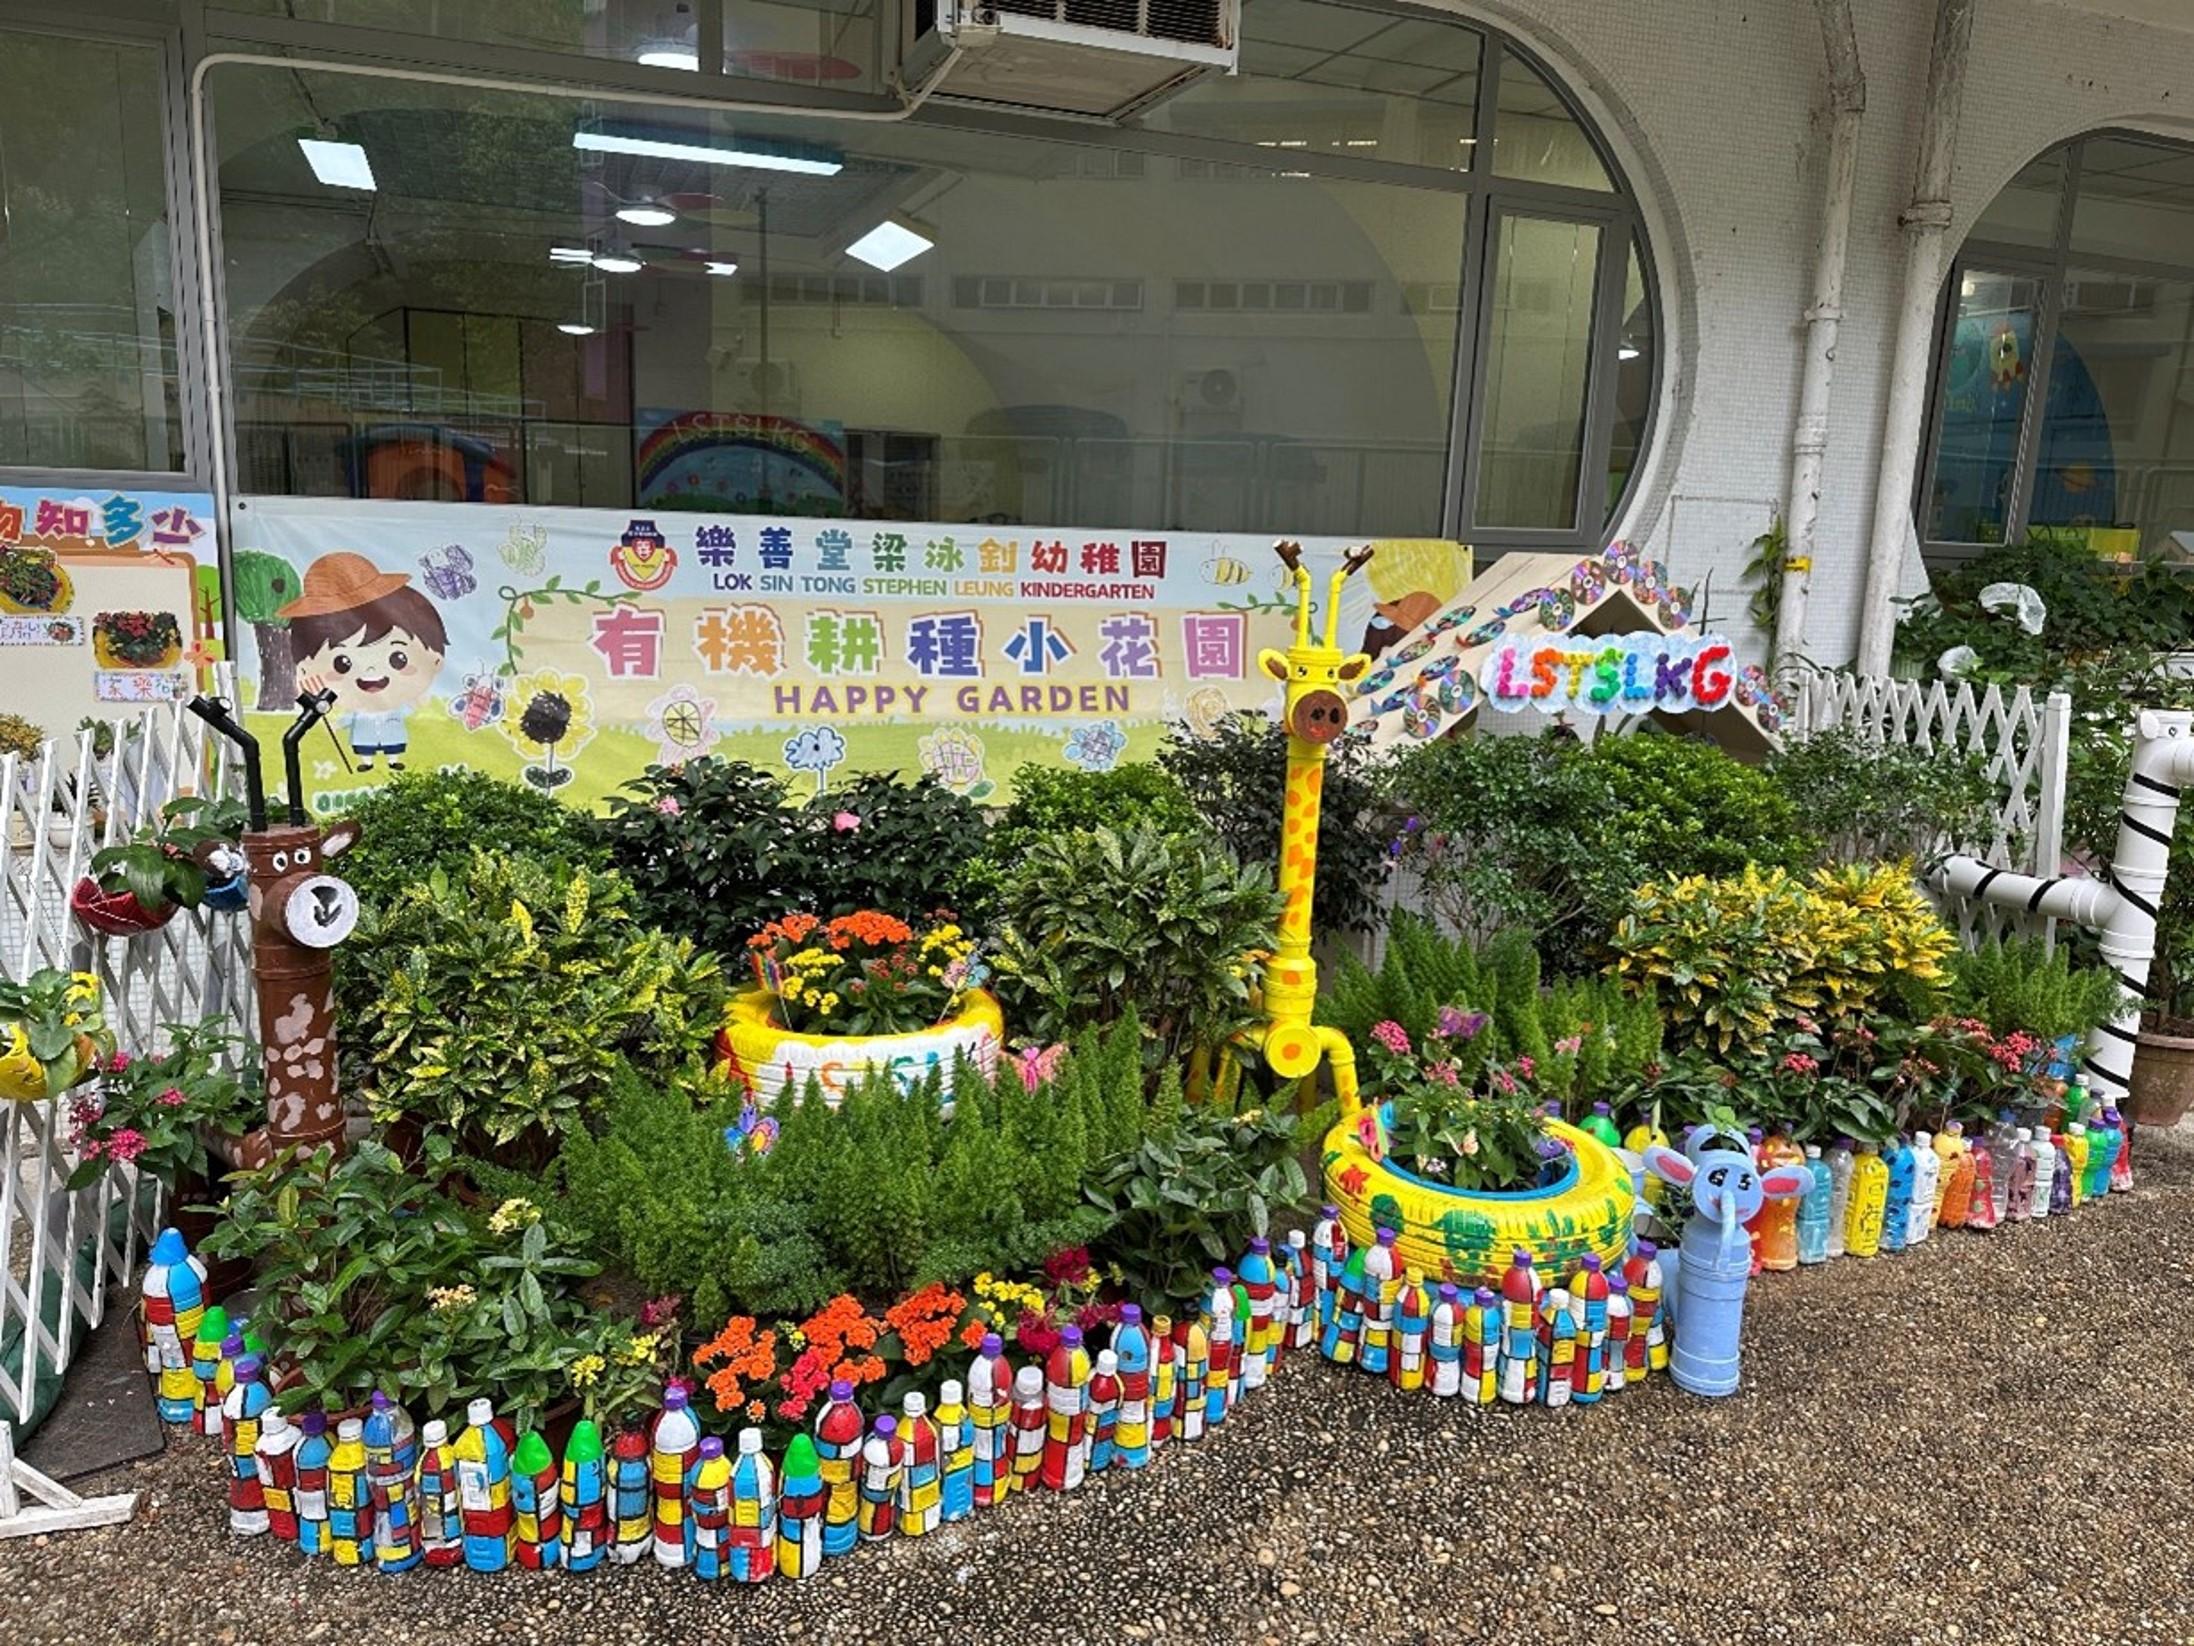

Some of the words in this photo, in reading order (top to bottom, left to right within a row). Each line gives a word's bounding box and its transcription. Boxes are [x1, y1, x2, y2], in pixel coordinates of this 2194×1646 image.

[695, 525, 1168, 579] 樂善堂梁泳釗幼稚園
[713, 573, 752, 591] LOK
[760, 575, 793, 592] SIN
[801, 577, 856, 594] TONG
[863, 578, 947, 596] STEPHEN
[955, 580, 1014, 597] LEUNG
[1021, 582, 1155, 599] KINDERGARTEN
[591, 606, 1242, 680] 有機耕種小花園
[774, 685, 928, 714] HAPPY
[957, 685, 1130, 713] GARDEN
[1496, 645, 1732, 705] LSTSLKG
